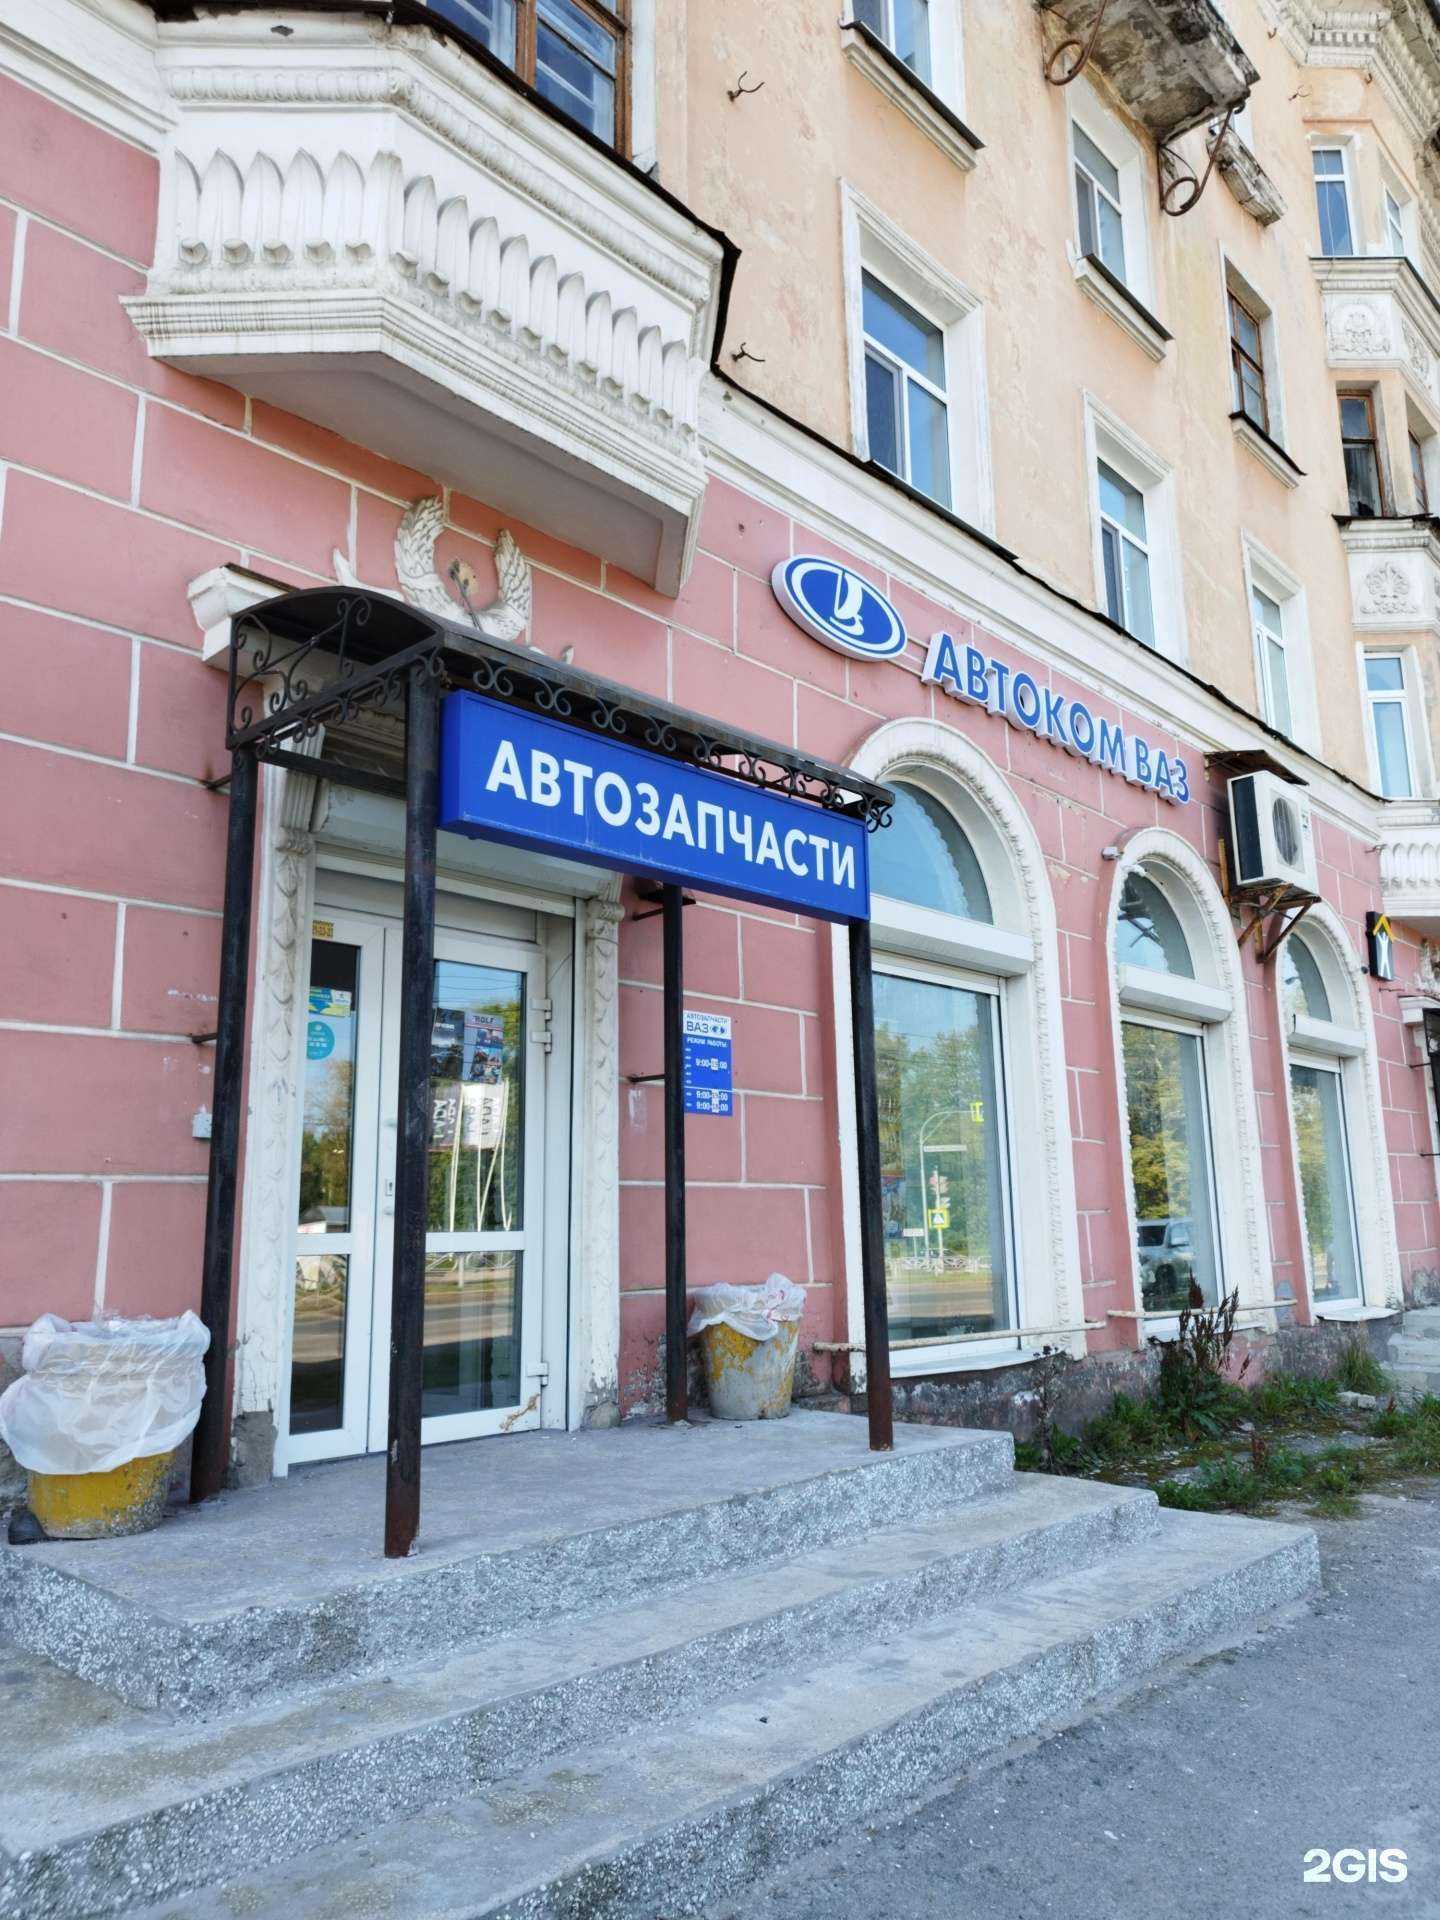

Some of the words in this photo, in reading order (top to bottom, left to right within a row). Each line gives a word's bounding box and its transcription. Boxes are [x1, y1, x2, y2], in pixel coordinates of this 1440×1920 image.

[930, 632, 1128, 776] АВТОКОМ
[1134, 736, 1191, 804] ВАЗ
[485, 739, 856, 890] АВТОЗАПЧАСТИ
[686, 1012, 729, 1024] АВТОЗАПЧАСТИ
[686, 1021, 709, 1034] ВАЗ
